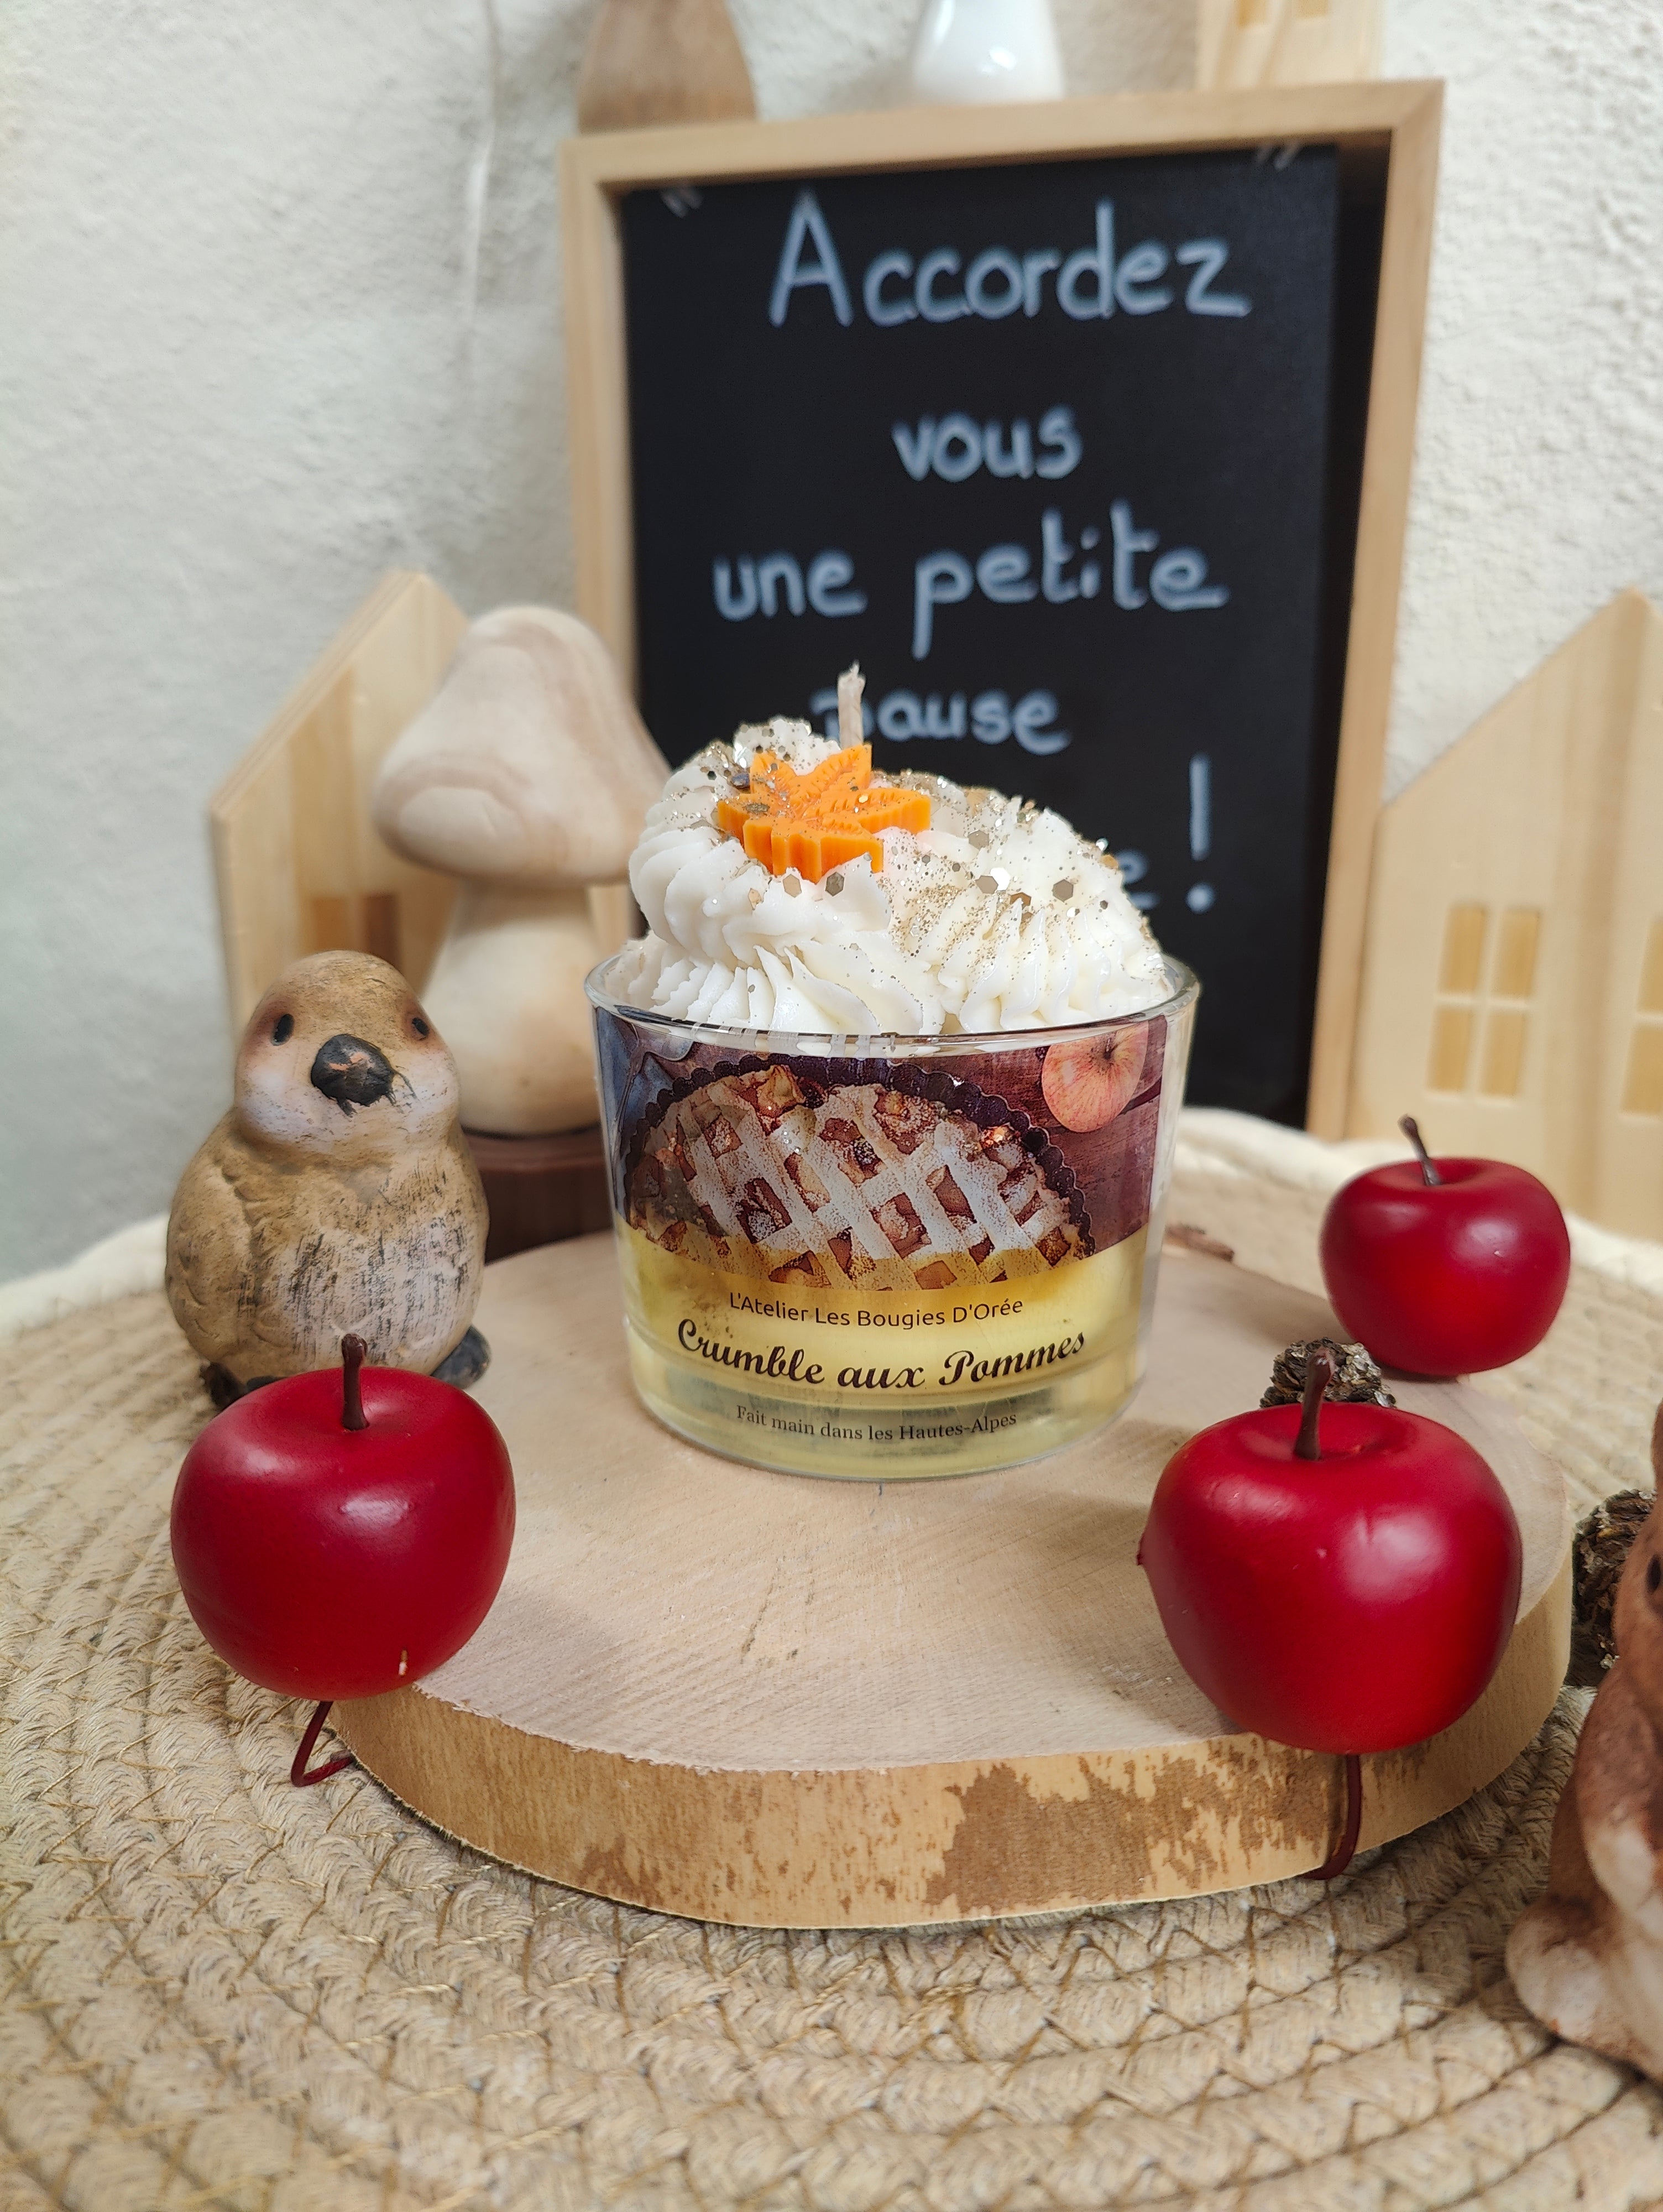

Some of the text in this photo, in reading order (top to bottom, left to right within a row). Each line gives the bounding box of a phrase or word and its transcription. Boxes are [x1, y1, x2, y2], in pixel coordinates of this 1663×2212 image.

[768, 191, 1253, 327] Accordez
[891, 406, 1082, 483] vous
[712, 501, 1230, 660] une petite
[729, 1291, 1024, 1331] L'Atelier Les Bougies D'Orée
[677, 1317, 1085, 1390] Crumble aux Pommes
[735, 1404, 1017, 1441] Fait main dans les Hautes-Alpes
